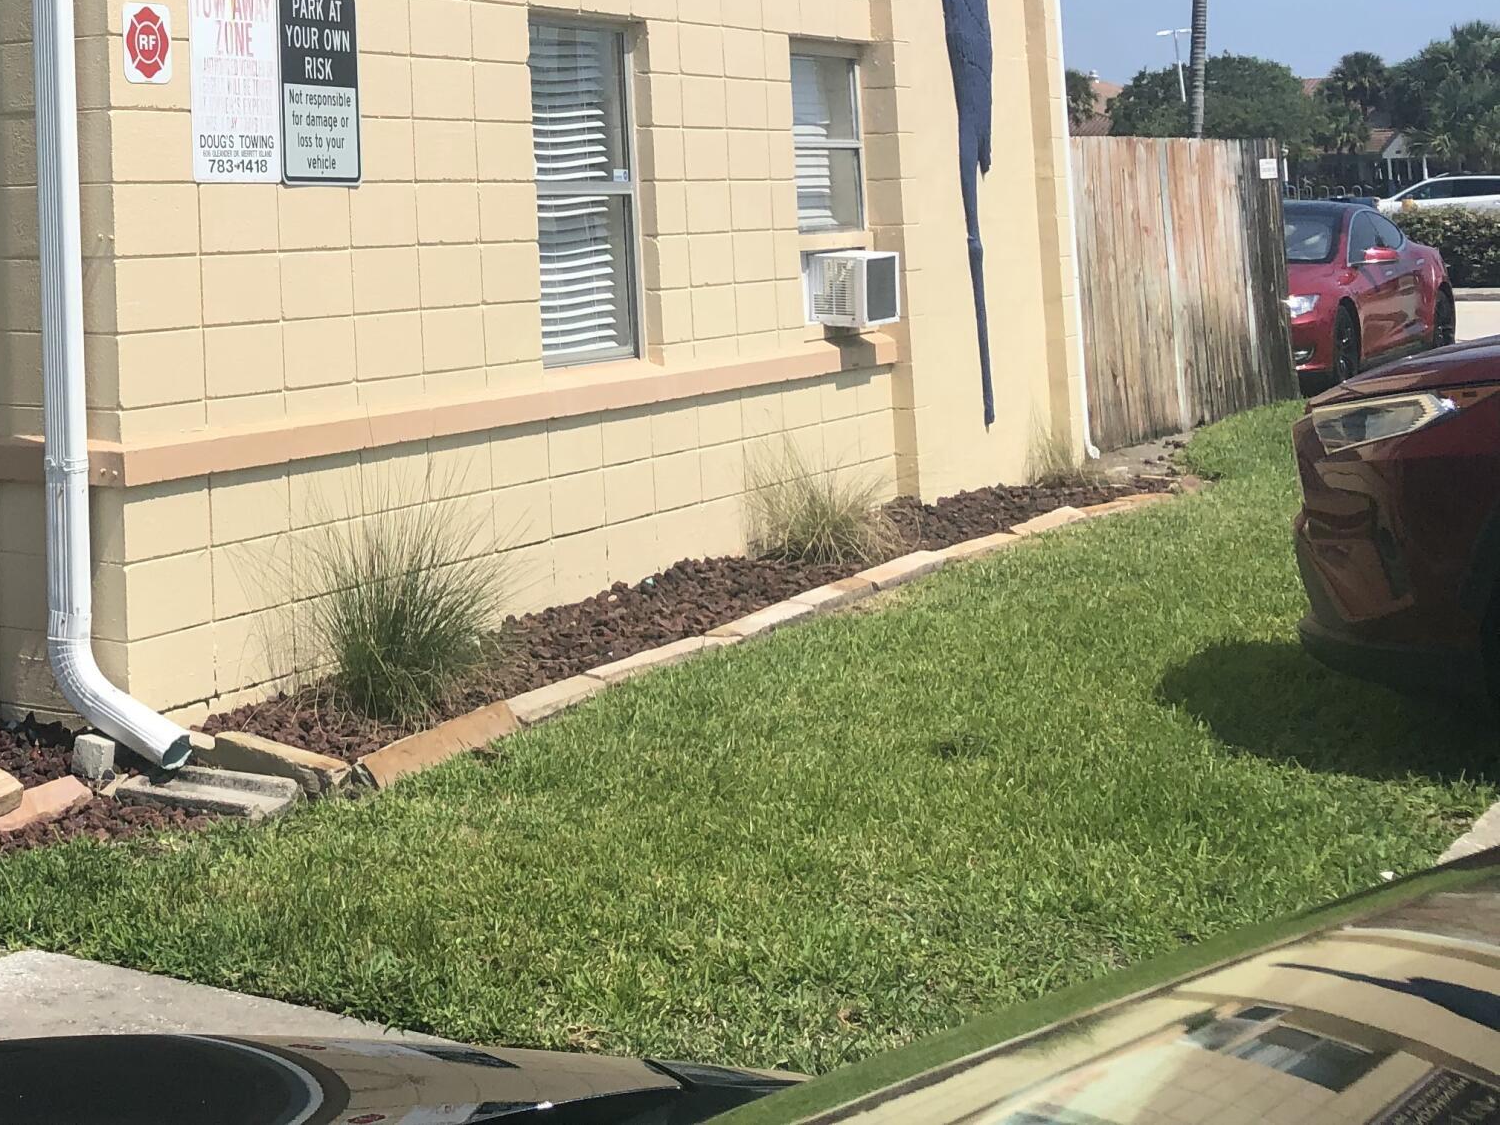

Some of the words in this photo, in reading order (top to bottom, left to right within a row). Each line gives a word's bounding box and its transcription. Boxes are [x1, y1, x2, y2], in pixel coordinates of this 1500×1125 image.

[328, 0, 342, 23] AT
[138, 34, 157, 51] RF
[285, 24, 318, 49] YOUR
[323, 28, 350, 53] OWN
[304, 56, 333, 81] RISK
[289, 88, 303, 104] Not
[305, 90, 351, 113] responsible
[292, 110, 303, 126] for
[306, 111, 338, 132] damage
[341, 116, 349, 128] or
[199, 134, 235, 149] DOUG'S
[239, 134, 275, 150] TOWING
[297, 131, 313, 148] loss
[315, 133, 323, 149] to
[326, 136, 344, 153] your
[307, 153, 337, 170] vehicle
